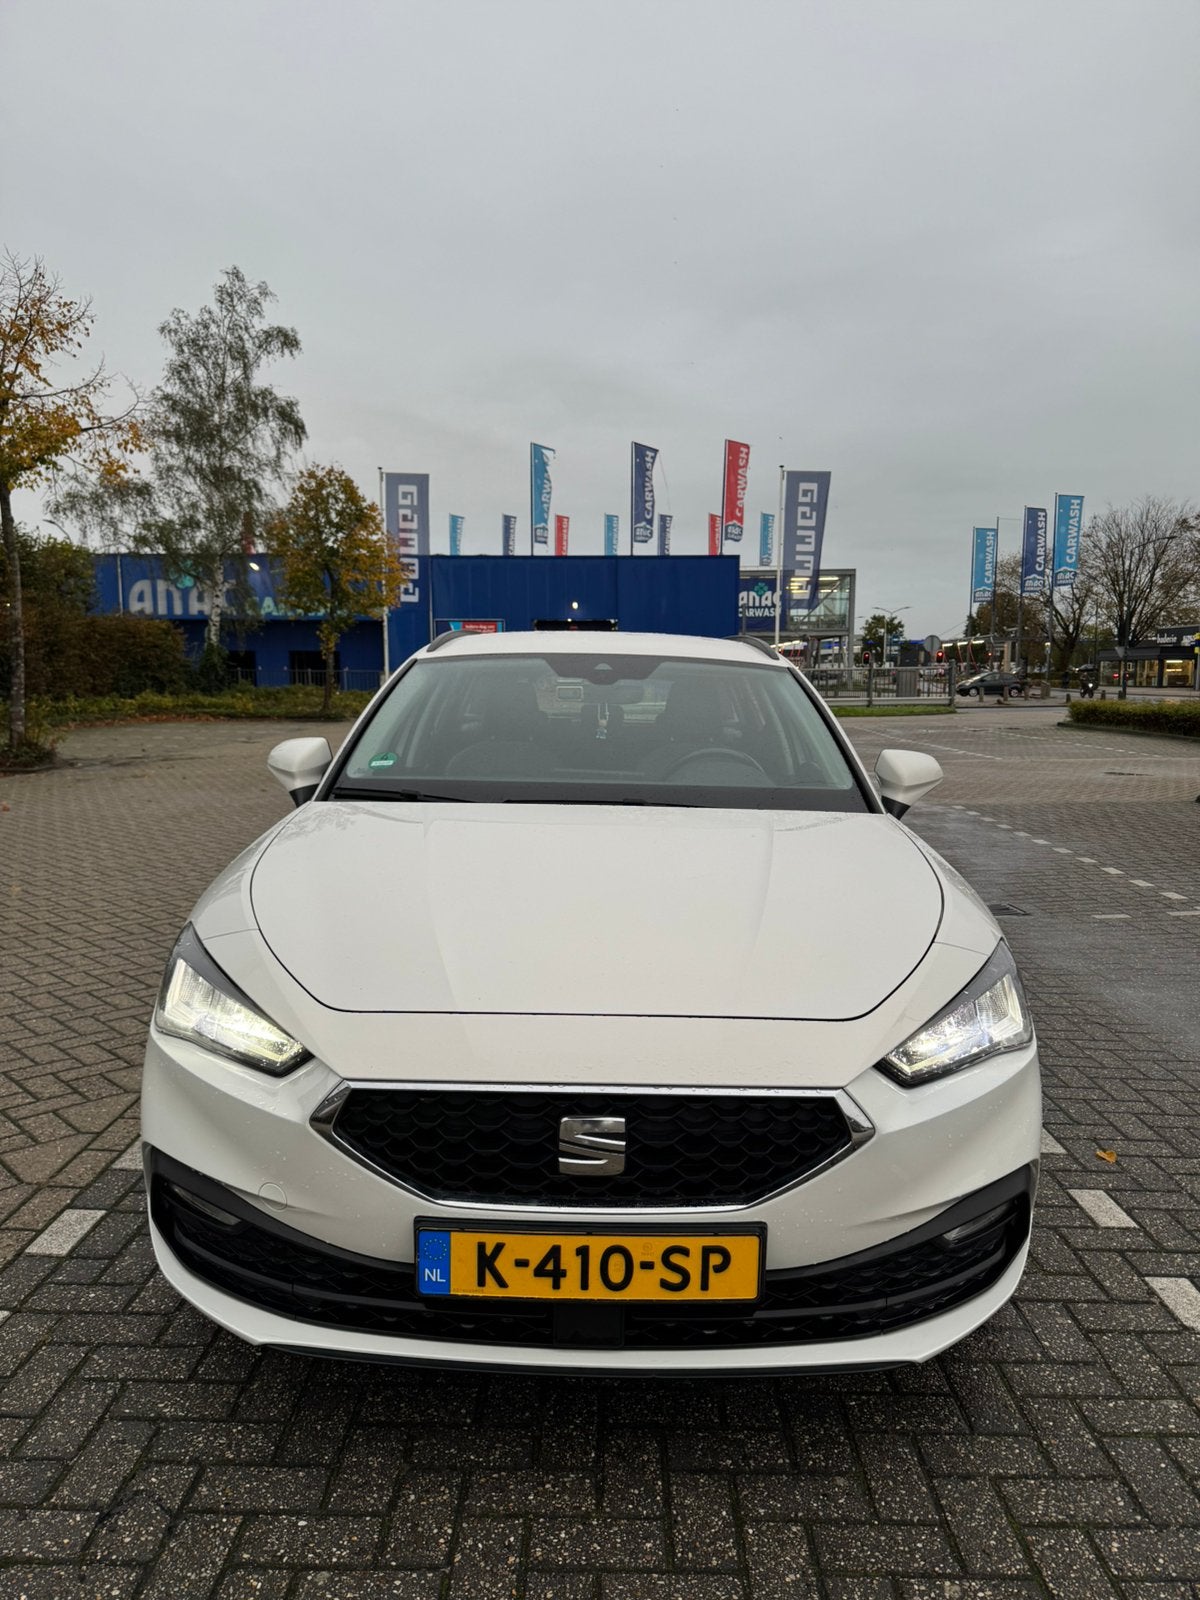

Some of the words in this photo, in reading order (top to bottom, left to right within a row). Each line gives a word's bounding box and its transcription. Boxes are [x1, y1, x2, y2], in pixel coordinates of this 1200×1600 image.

[645, 451, 655, 519] CARWASH
[398, 484, 419, 603] GAMMA
[795, 482, 818, 600] GAMMA
[984, 531, 995, 584] CARWASH
[1035, 511, 1046, 571] CARWASH
[1066, 499, 1081, 563] CARWASH
[738, 607, 782, 618] CRWAS
[424, 1268, 446, 1282] NL
[476, 1241, 732, 1292] K-410-SP
